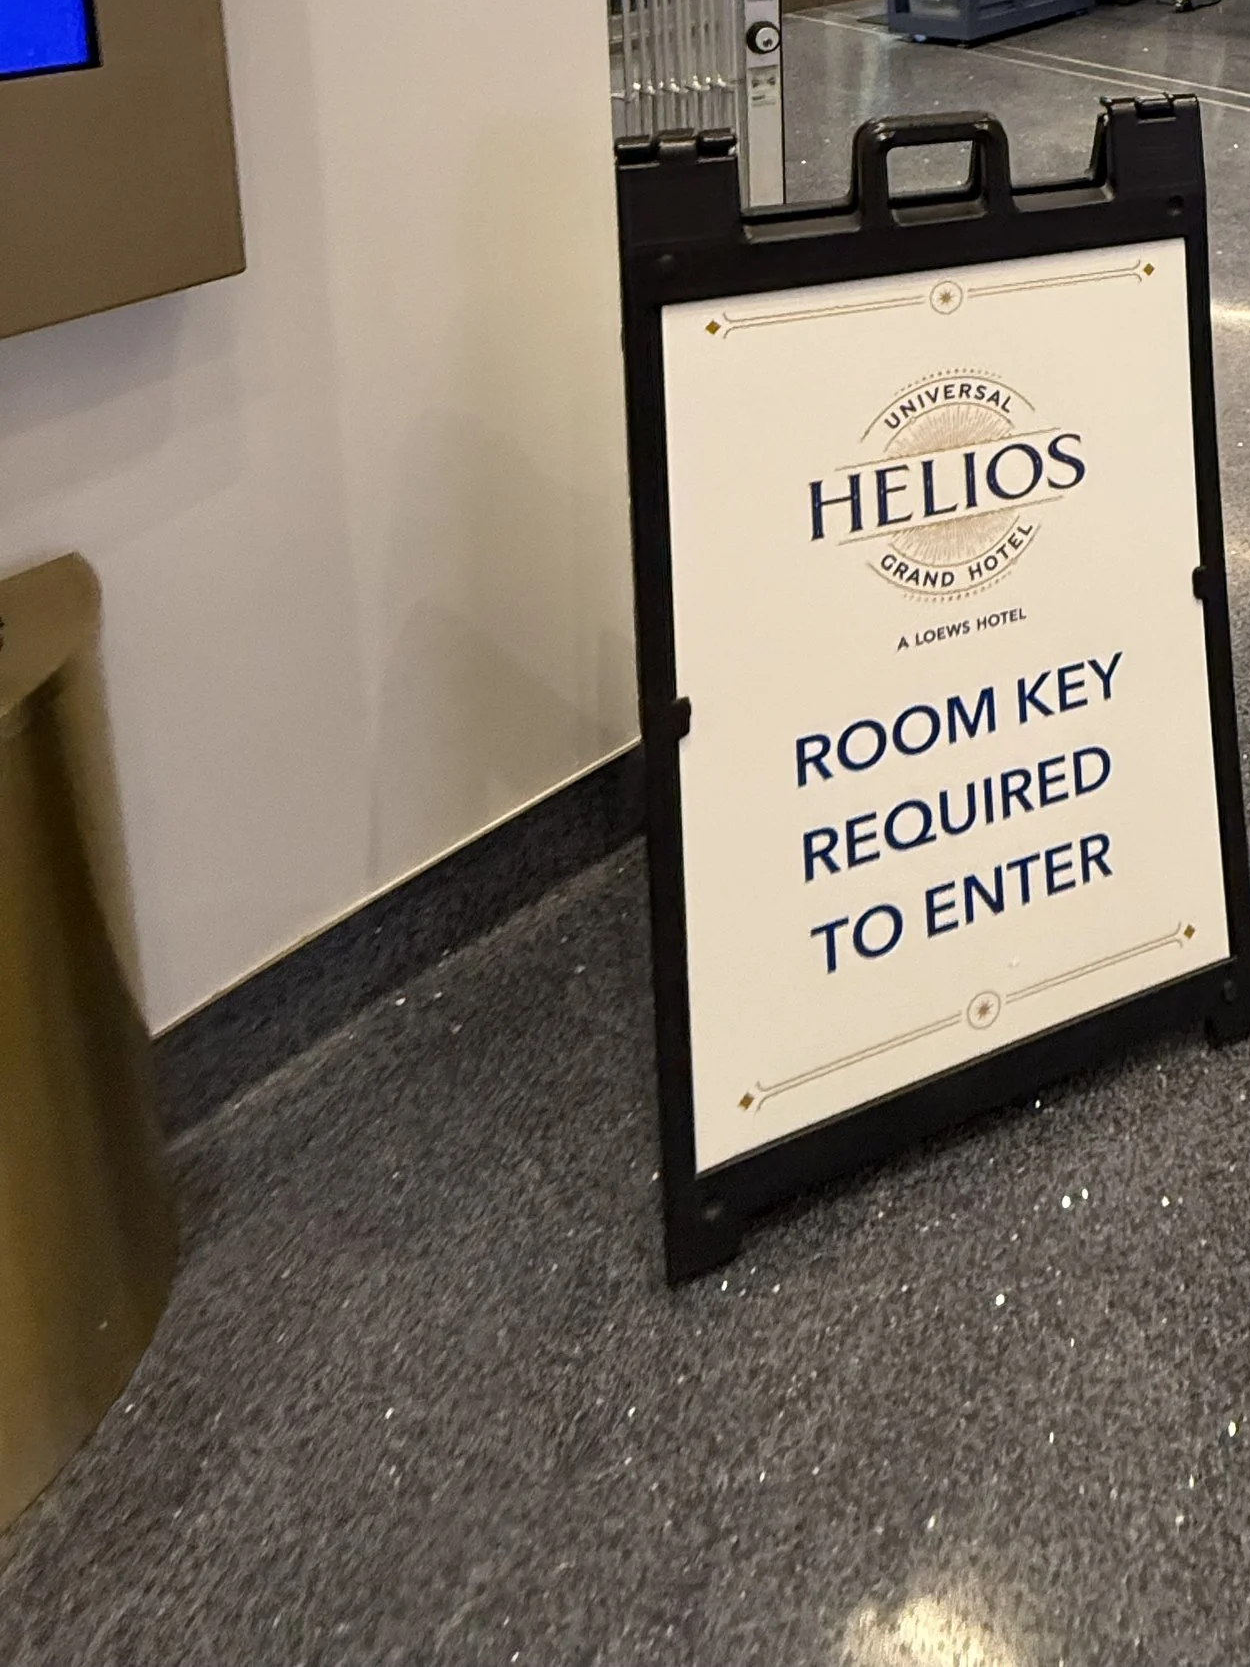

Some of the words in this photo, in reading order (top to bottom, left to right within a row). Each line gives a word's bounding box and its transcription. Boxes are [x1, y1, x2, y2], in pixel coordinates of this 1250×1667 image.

[884, 383, 1013, 430] UNIVERSAL
[808, 433, 1086, 542] HELIOS
[880, 553, 955, 588] GRAND
[968, 524, 1033, 581] HOTEL
[896, 636, 909, 652] A
[915, 620, 971, 647] LOEWS
[976, 607, 1027, 631] HOTEL
[796, 686, 997, 788] ROOM
[1017, 651, 1123, 725] KEY
[803, 746, 1112, 883] REQUIRED
[810, 903, 903, 974] TO
[925, 833, 1113, 939] ENTER
